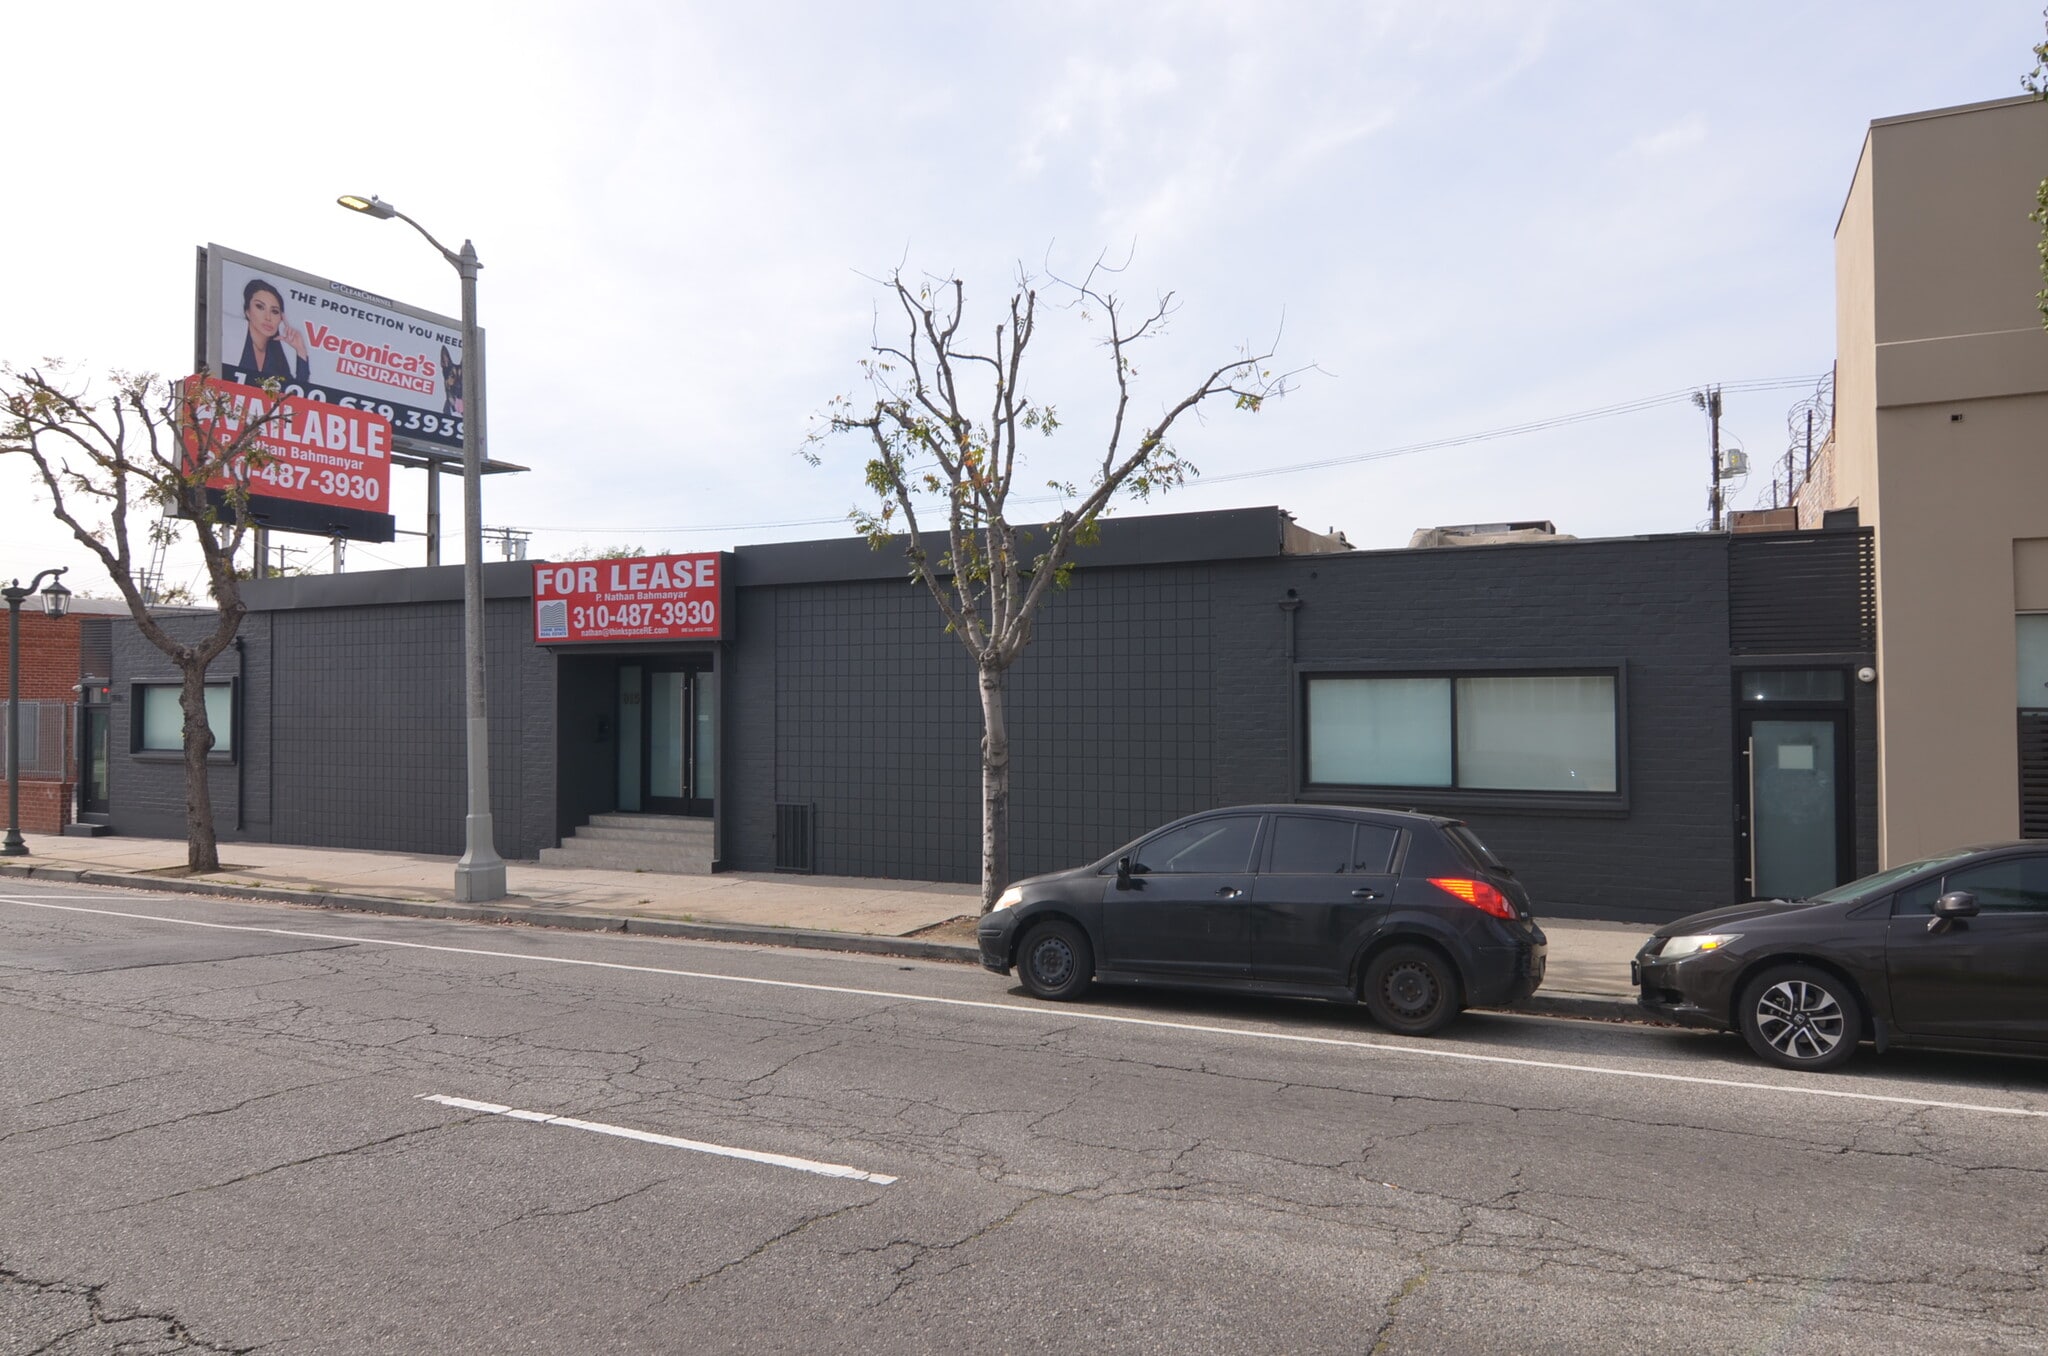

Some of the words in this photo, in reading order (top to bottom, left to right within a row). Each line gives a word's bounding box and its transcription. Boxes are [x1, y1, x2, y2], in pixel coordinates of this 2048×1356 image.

[289, 289, 317, 306] THE
[321, 298, 404, 331] PROTECTION
[408, 324, 433, 339] YOU
[304, 321, 436, 377] Veronica's
[340, 360, 433, 393] INSURANCE
[196, 389, 385, 459] AVAILABLE
[290, 446, 364, 471] Bahmanyar
[536, 566, 598, 596] FOR
[610, 559, 715, 592] LEASE
[604, 591, 635, 601] Nathan
[637, 591, 688, 601] Bahmanyar
[573, 600, 715, 629] 310-487-3930
